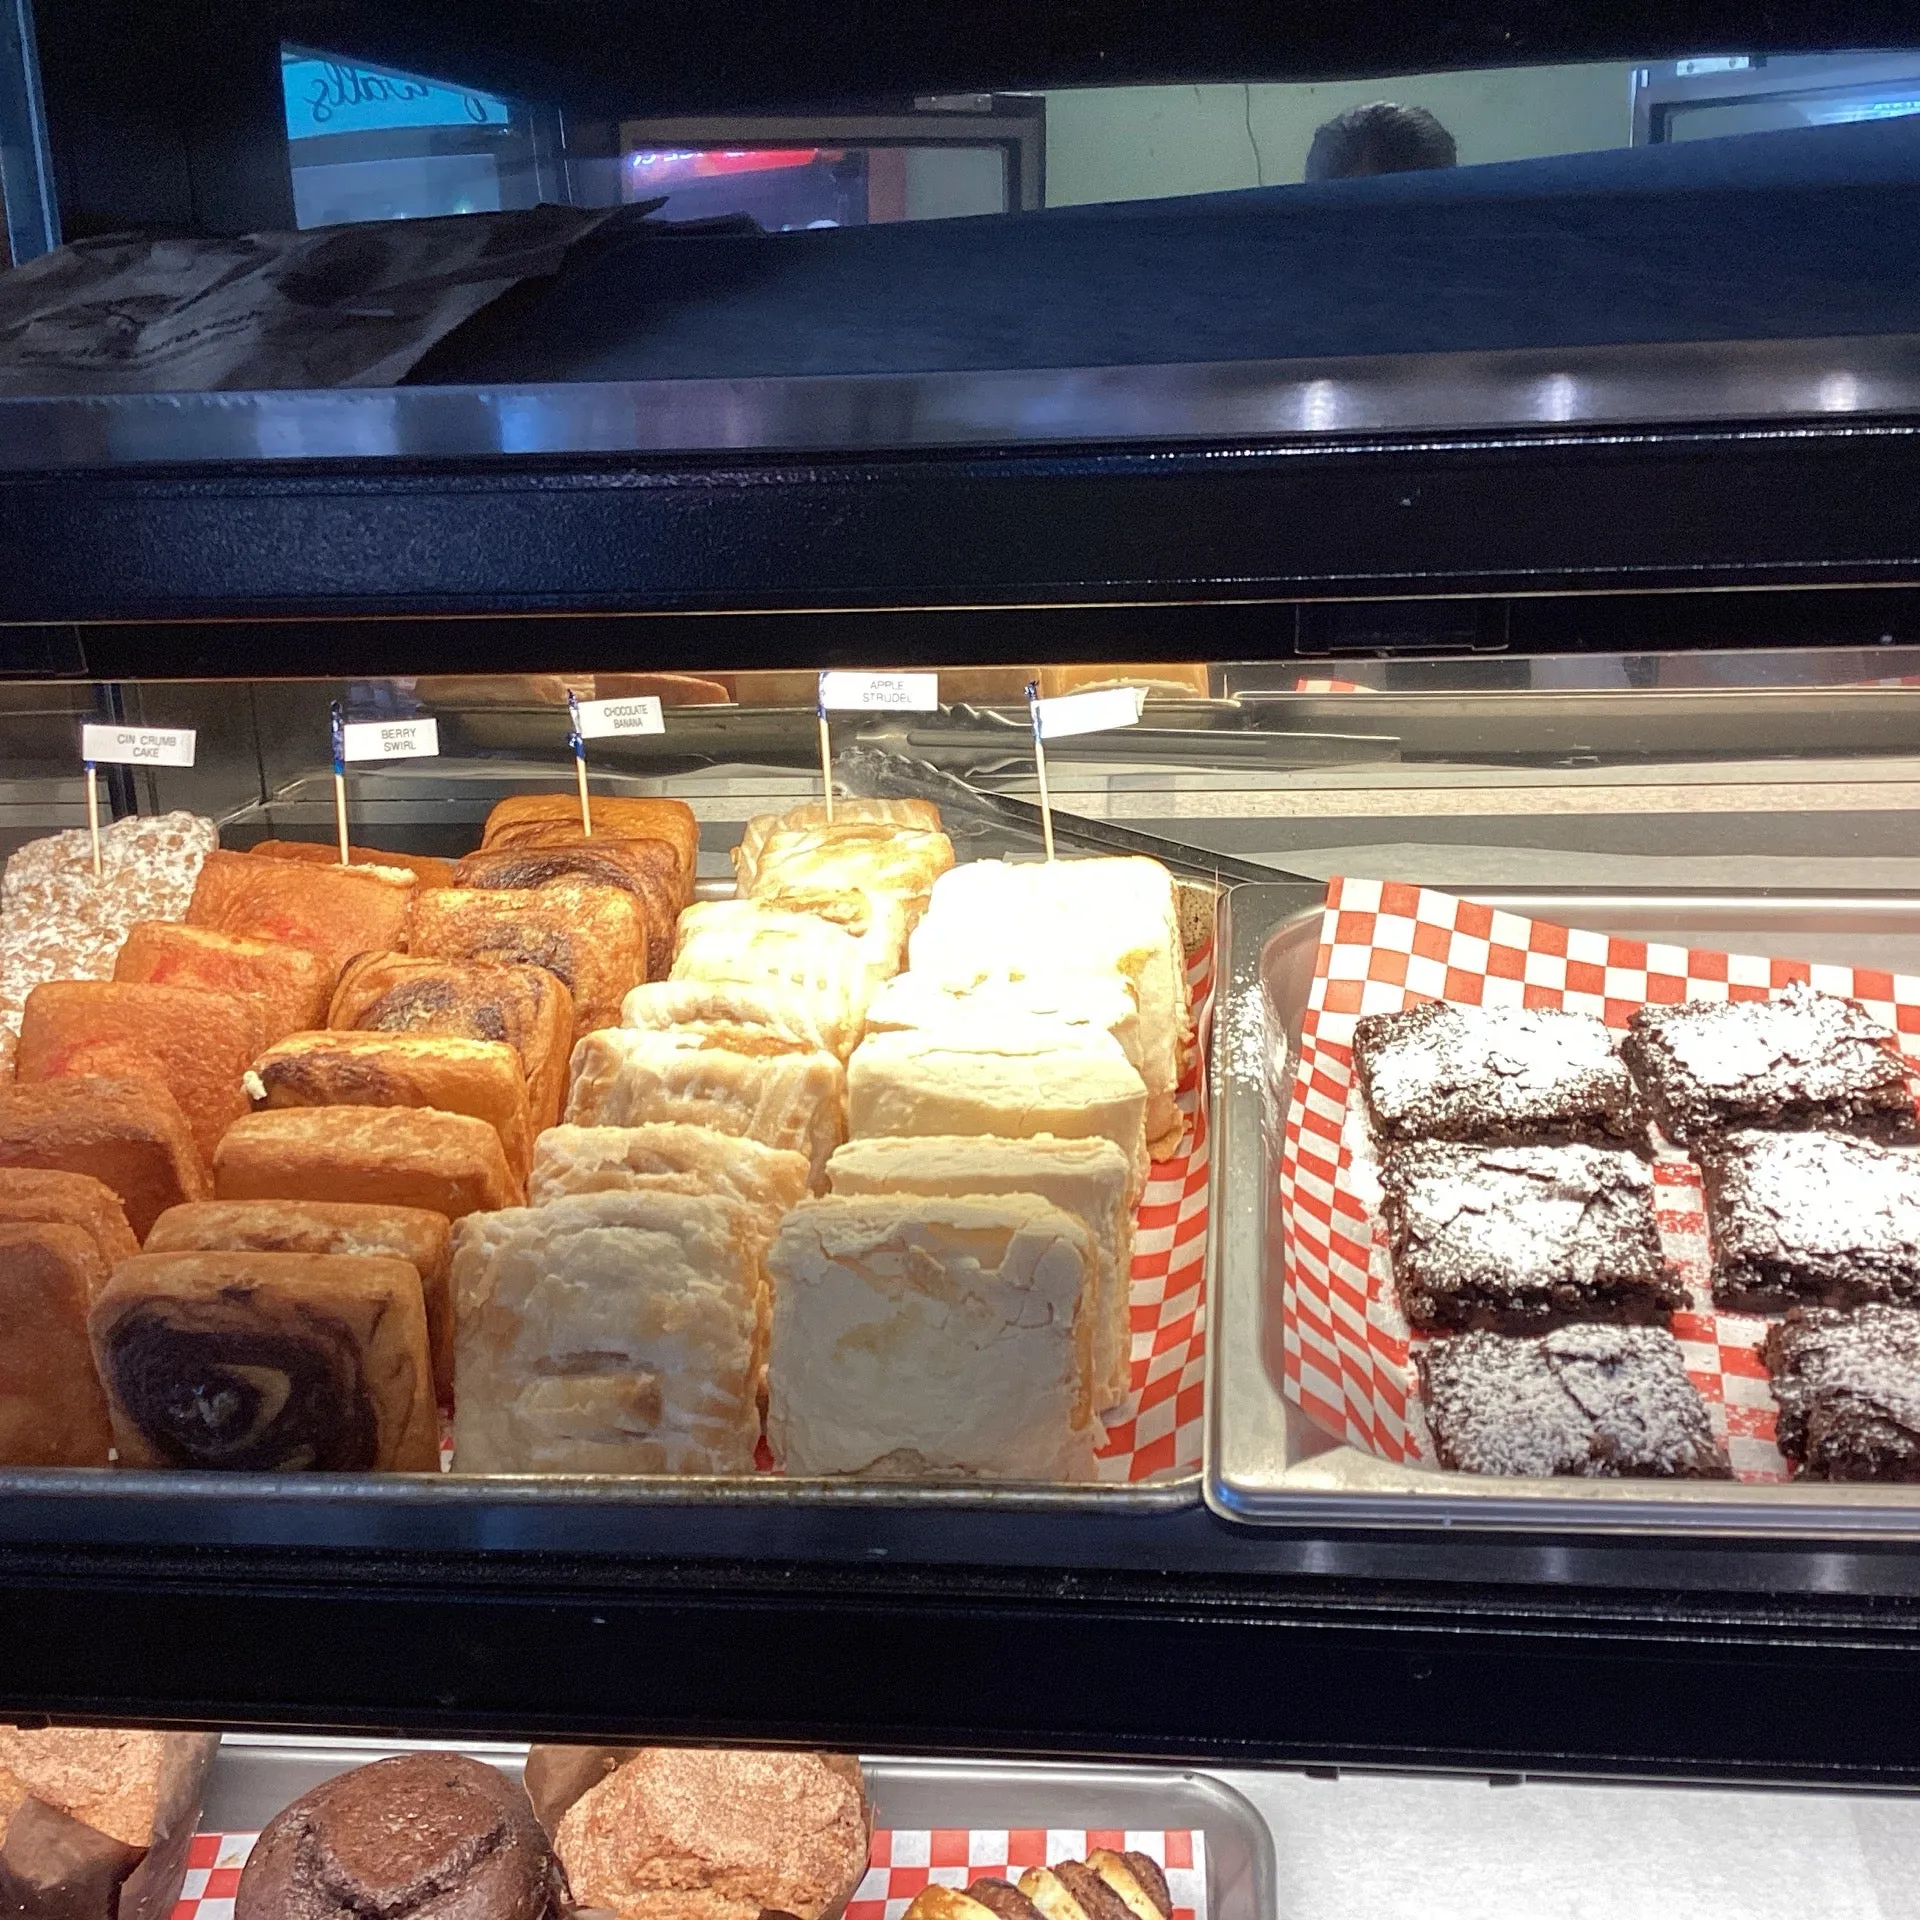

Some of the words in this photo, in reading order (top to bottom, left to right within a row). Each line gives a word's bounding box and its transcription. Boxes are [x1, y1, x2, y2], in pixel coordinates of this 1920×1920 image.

[870, 680, 904, 690] APPLE
[862, 692, 912, 703] STRUDEL
[603, 704, 648, 717] CHOCOLATE
[613, 717, 643, 729] BANANA
[381, 728, 416, 739] BERRY
[117, 734, 135, 744] CIN
[140, 735, 176, 747] CRUMB
[384, 740, 416, 752] SWIRL
[132, 747, 159, 758] CAKE
